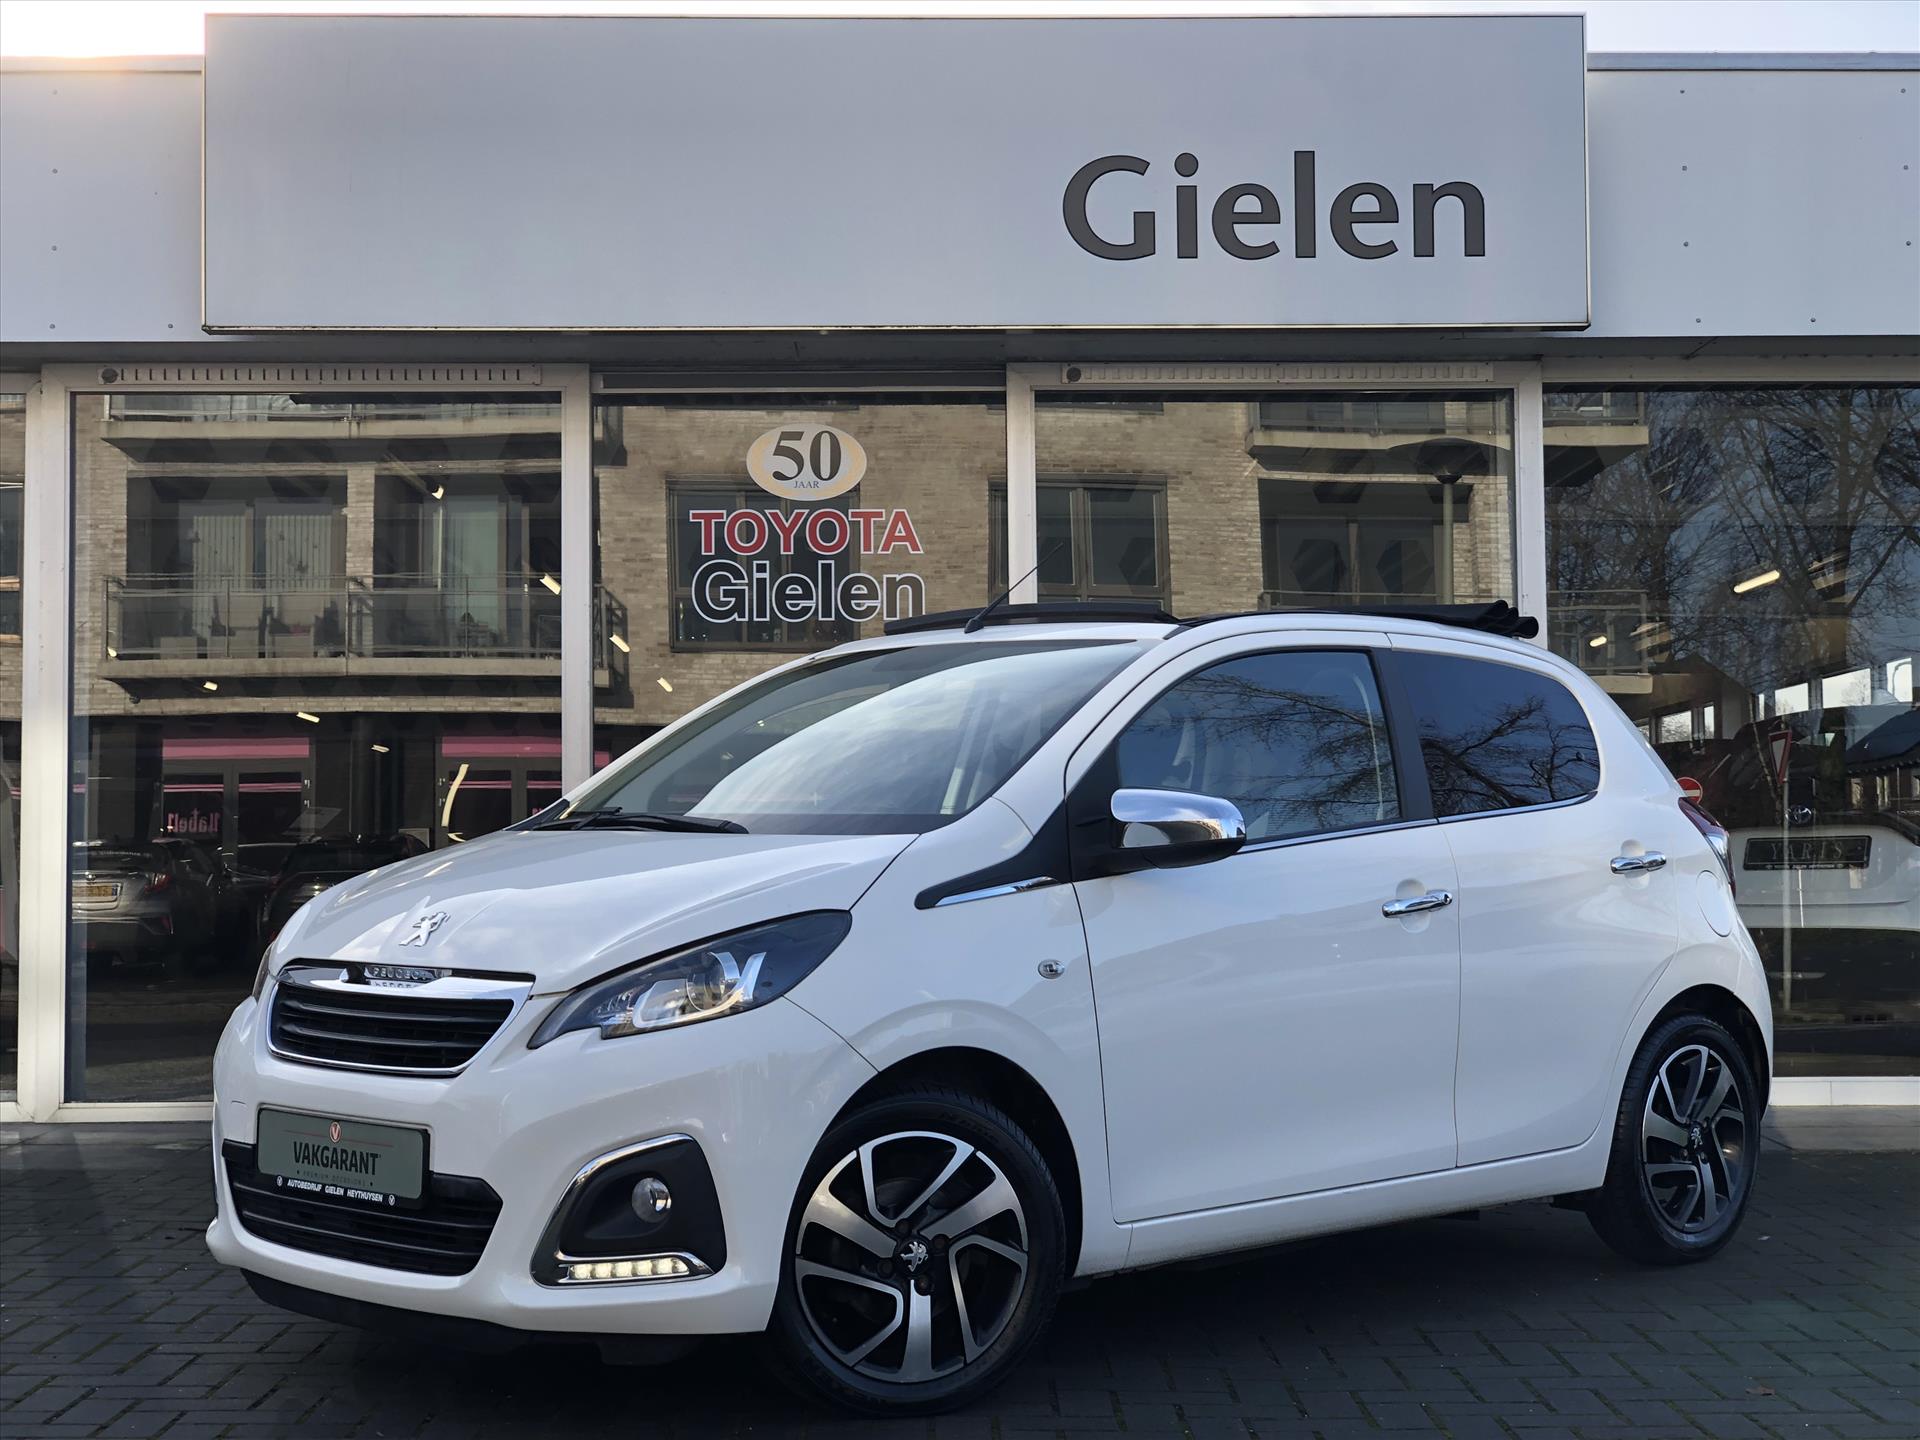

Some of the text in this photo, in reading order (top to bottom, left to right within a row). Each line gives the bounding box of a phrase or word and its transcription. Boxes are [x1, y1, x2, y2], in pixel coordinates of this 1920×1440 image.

[1063, 151, 1485, 260] Gielen
[772, 430, 842, 482] 50
[793, 480, 820, 489] JAAR
[689, 508, 924, 555] TOYOTA
[692, 559, 926, 623] Gielen
[1770, 840, 1844, 861] YARIS
[293, 1141, 379, 1175] VAKGARANT
[287, 1179, 383, 1202] AUTOBEDRIJF GIELEN HEYTHUYSEN
